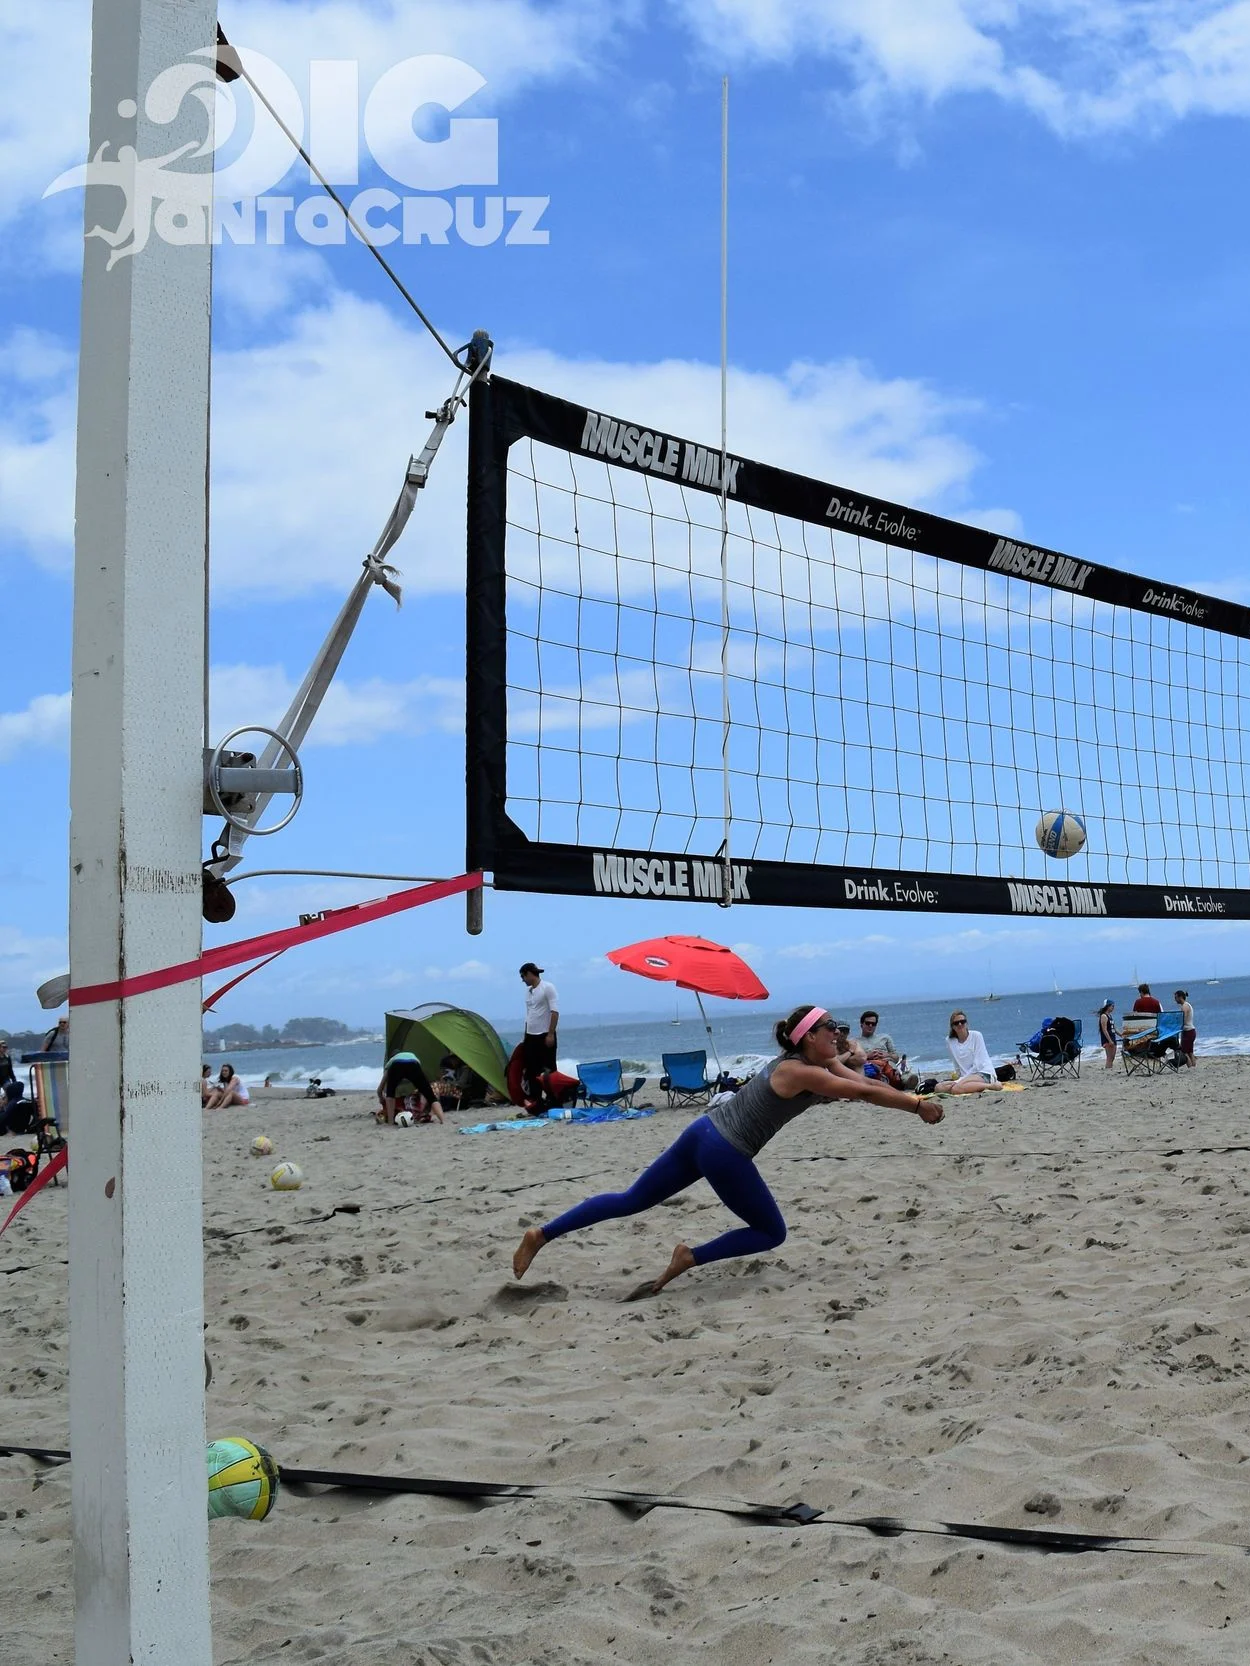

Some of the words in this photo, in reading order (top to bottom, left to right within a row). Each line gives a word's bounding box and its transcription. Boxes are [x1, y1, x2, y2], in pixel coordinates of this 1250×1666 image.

[581, 411, 680, 476] MUSCLE
[681, 443, 740, 494] MILK
[825, 497, 873, 529] Drink.
[987, 538, 1055, 581] MUSCLE
[1048, 556, 1092, 590] MILK
[592, 853, 690, 896] MUSCLE
[691, 860, 751, 900] MIK
[844, 878, 894, 902] Drink.
[1007, 882, 1070, 914] MUSCLE
[1068, 886, 1107, 915] MILK
[1163, 895, 1197, 913] Drink.
